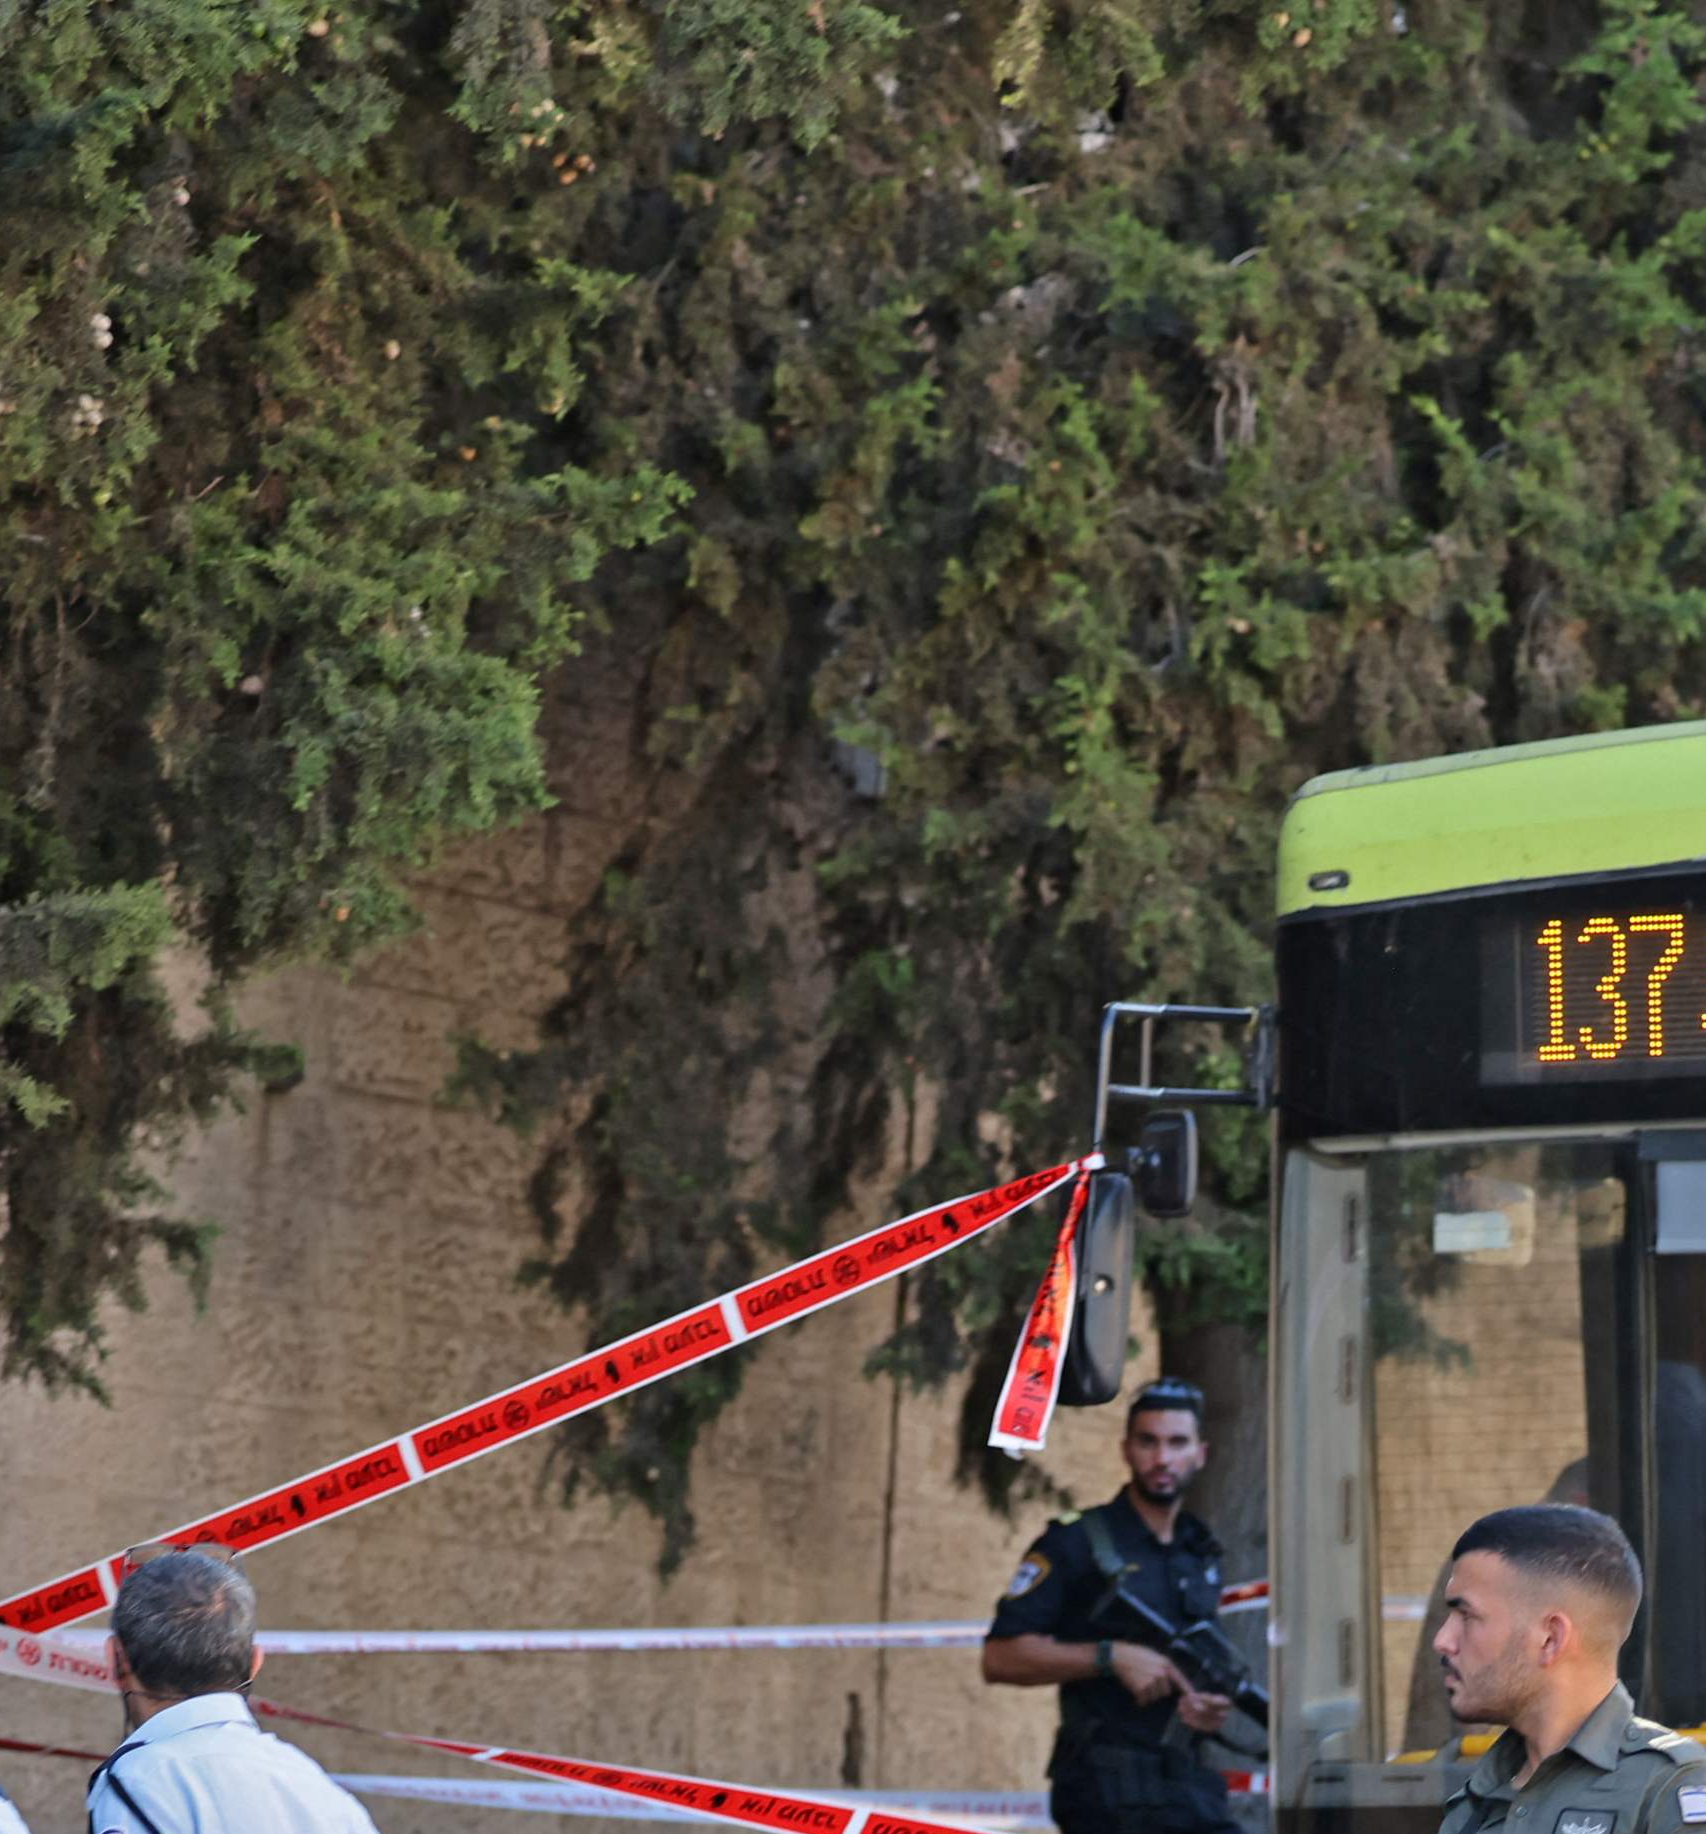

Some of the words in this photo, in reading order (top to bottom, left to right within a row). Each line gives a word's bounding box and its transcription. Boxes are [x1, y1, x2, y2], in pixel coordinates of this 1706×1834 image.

[1535, 913, 1684, 1062] 137
[747, 1267, 826, 1319] משטרת
[865, 1223, 938, 1267] ישראל
[422, 1411, 500, 1460] משטרת
[534, 1372, 600, 1413] ישראל
[662, 1318, 722, 1354] מעבר
[347, 1455, 399, 1494] מעבר
[774, 1805, 839, 1832] מעבר
